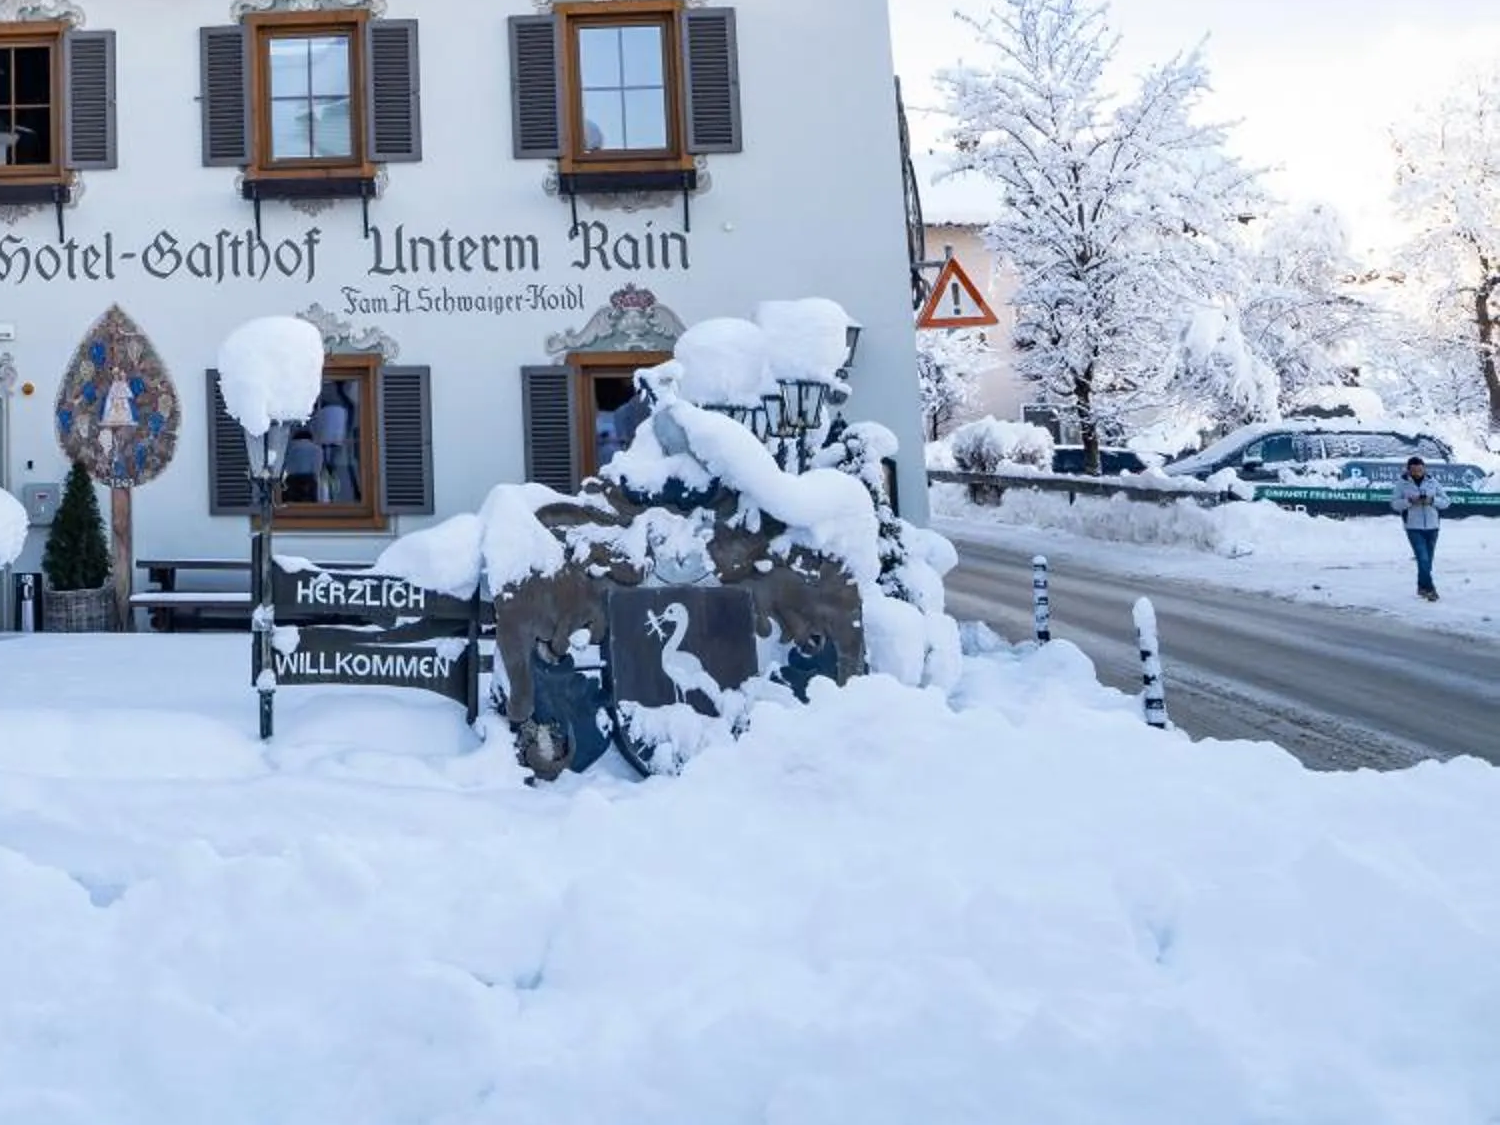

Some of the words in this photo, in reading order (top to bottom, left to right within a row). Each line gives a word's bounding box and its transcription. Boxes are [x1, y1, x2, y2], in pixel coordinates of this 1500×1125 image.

[367, 224, 539, 275] Unterm
[567, 220, 691, 271] Rain
[297, 579, 425, 609] HERZLICH
[275, 651, 450, 678] WILLKOMMEN
